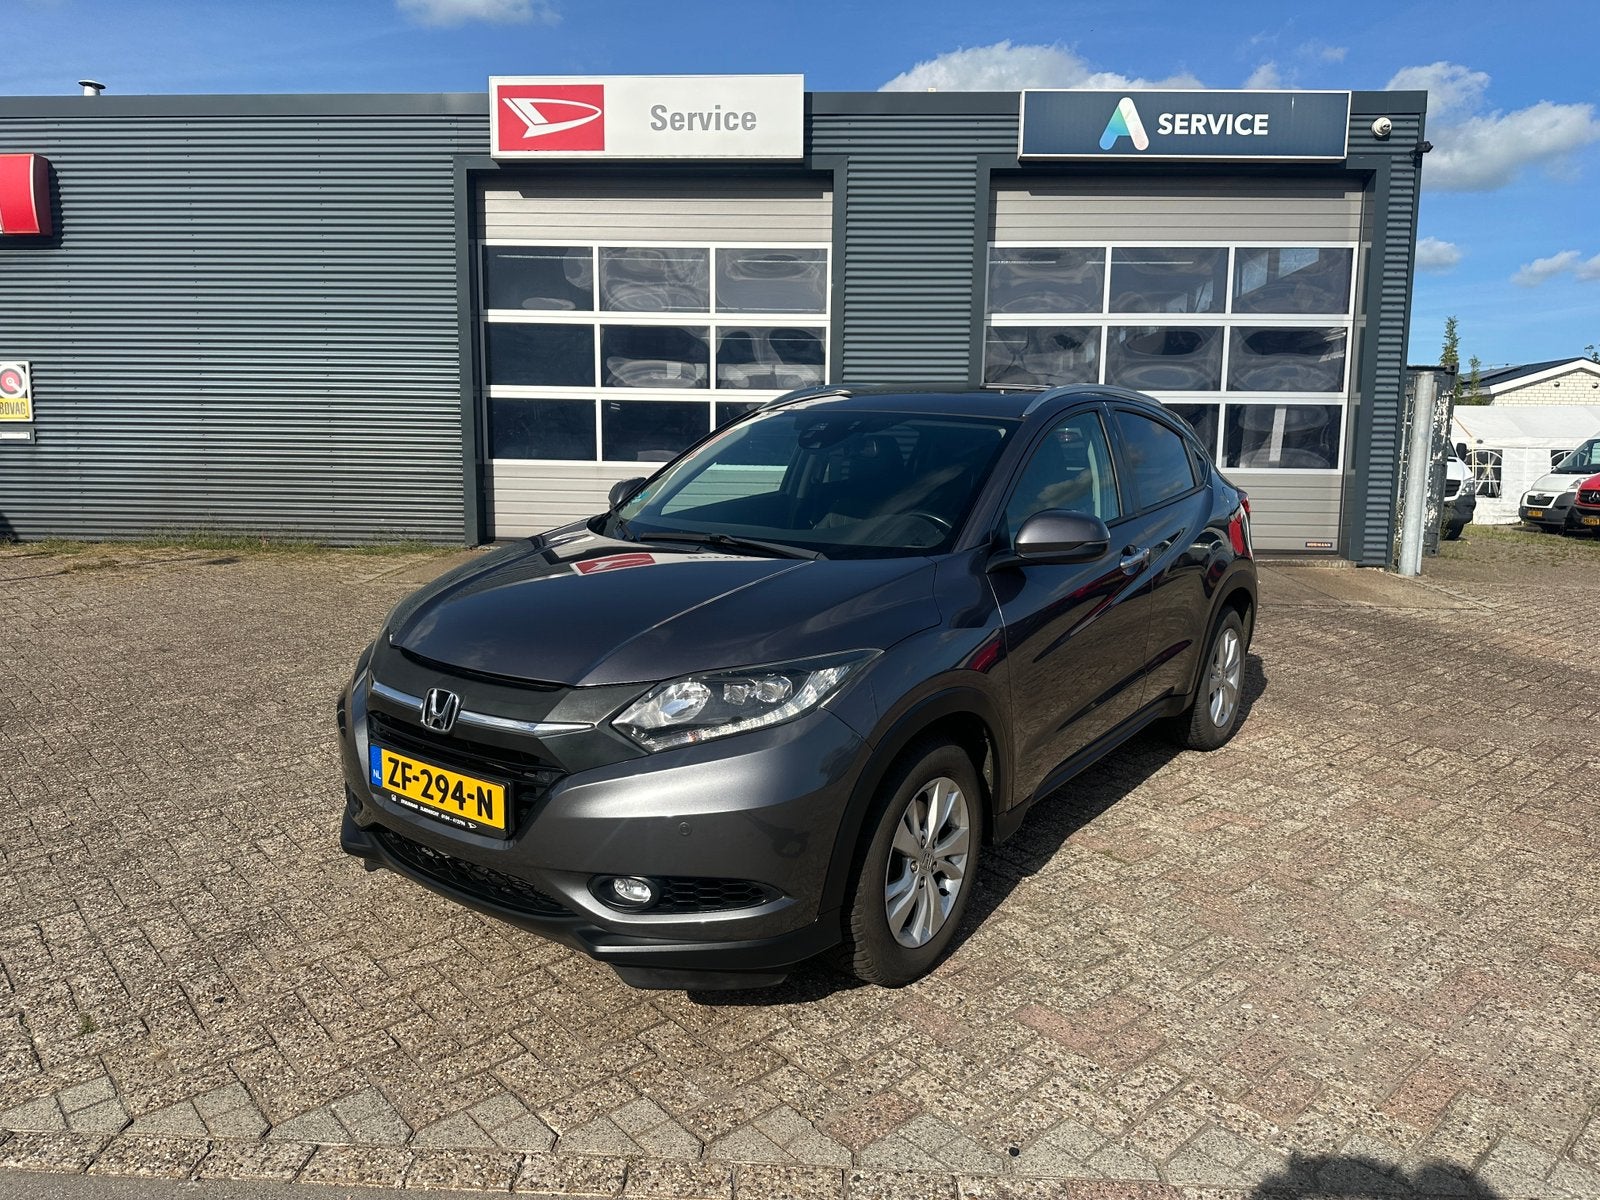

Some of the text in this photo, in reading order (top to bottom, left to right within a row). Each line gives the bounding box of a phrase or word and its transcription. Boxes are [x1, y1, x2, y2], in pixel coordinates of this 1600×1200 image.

[650, 104, 757, 131] Service
[1157, 112, 1269, 135] SERVICE
[0, 401, 26, 415] BOVAG
[372, 768, 382, 780] NL
[387, 756, 494, 820] ZF-294-N
